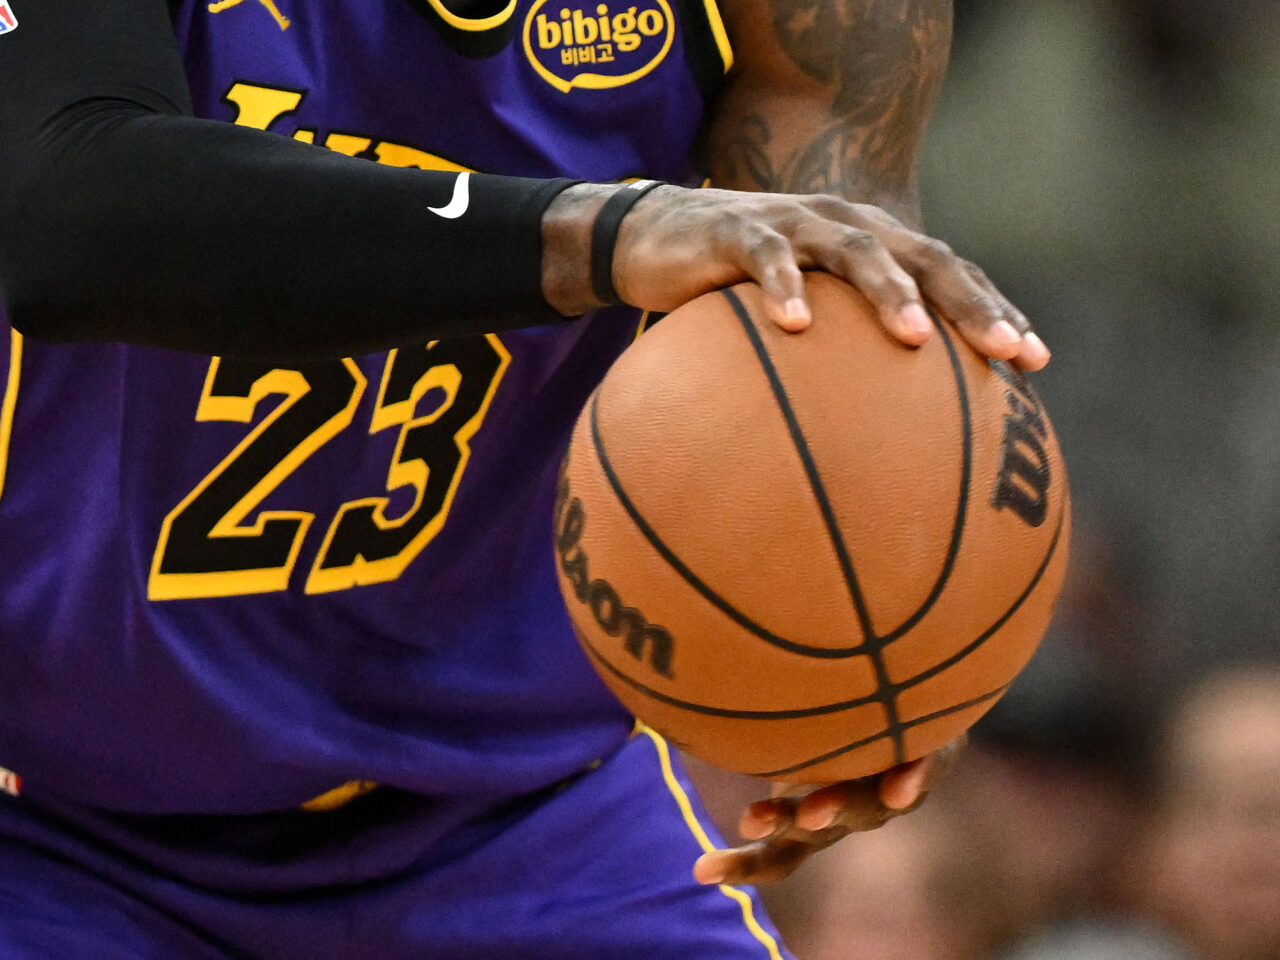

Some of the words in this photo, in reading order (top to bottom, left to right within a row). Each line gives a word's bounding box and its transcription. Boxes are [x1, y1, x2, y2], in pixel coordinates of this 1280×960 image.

[536, 3, 664, 51] bibigo
[560, 43, 615, 66] 비비고
[147, 333, 512, 601] 23
